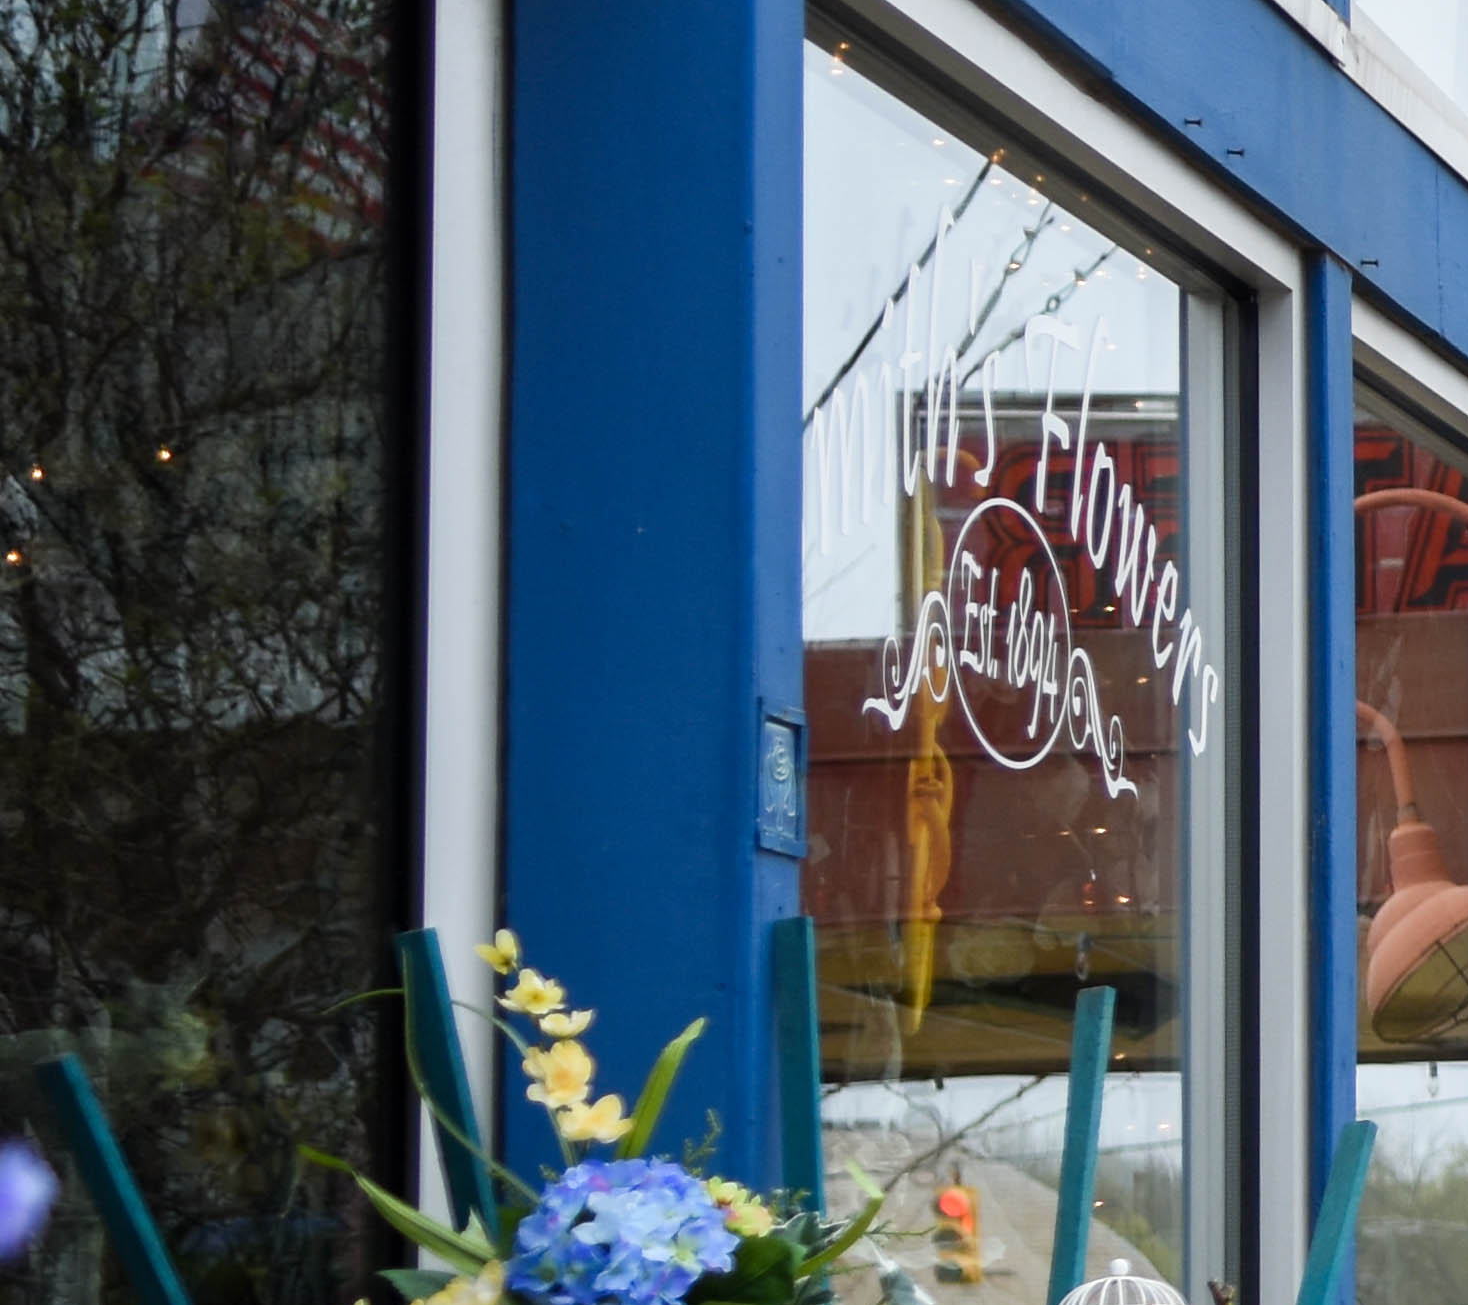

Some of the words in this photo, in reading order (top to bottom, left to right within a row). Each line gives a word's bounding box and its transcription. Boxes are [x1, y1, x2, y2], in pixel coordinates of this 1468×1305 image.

[810, 204, 1000, 555] mith's
[1025, 313, 1219, 758] Flowers
[958, 550, 998, 681] Est.
[1006, 566, 1061, 741] 1894
